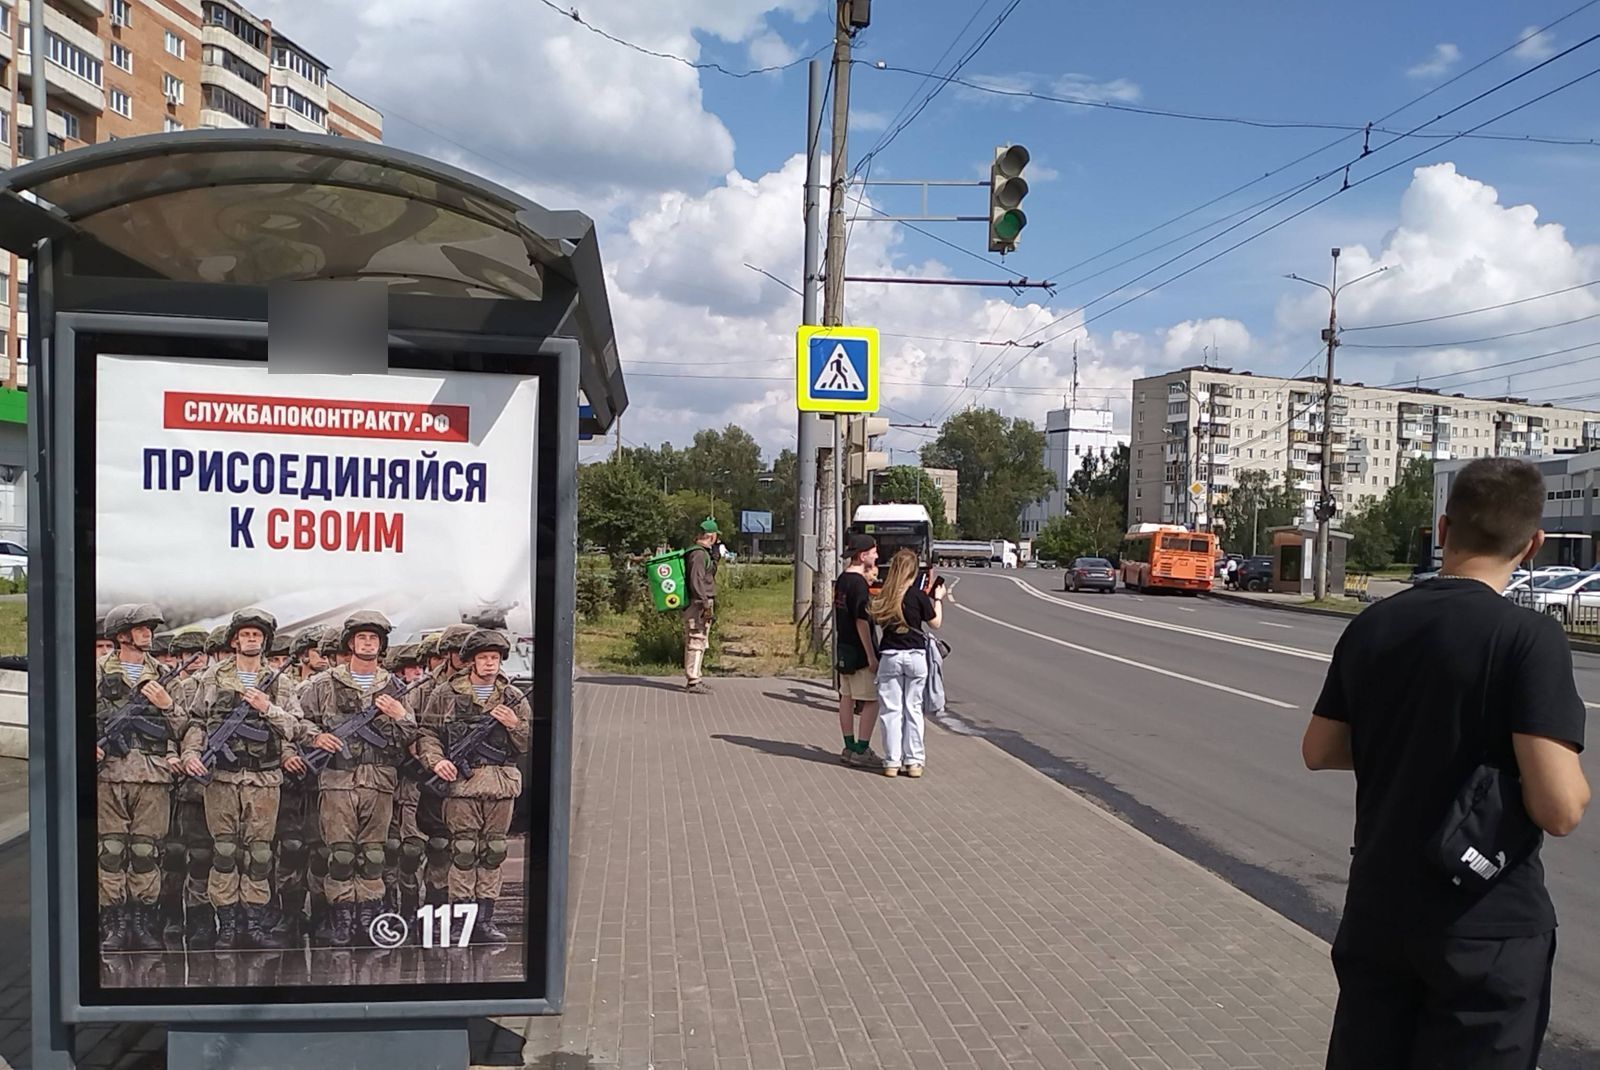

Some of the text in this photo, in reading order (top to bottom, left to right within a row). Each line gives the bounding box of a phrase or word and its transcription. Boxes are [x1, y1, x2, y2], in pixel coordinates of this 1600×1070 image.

[183, 400, 451, 434] СЛУЖБАПОКОНТРАКТУ.РФ
[142, 448, 487, 503] ПРИСОЕДИНЯЙСЯ
[230, 507, 404, 553] К СВОИМ
[417, 903, 479, 949] 117
